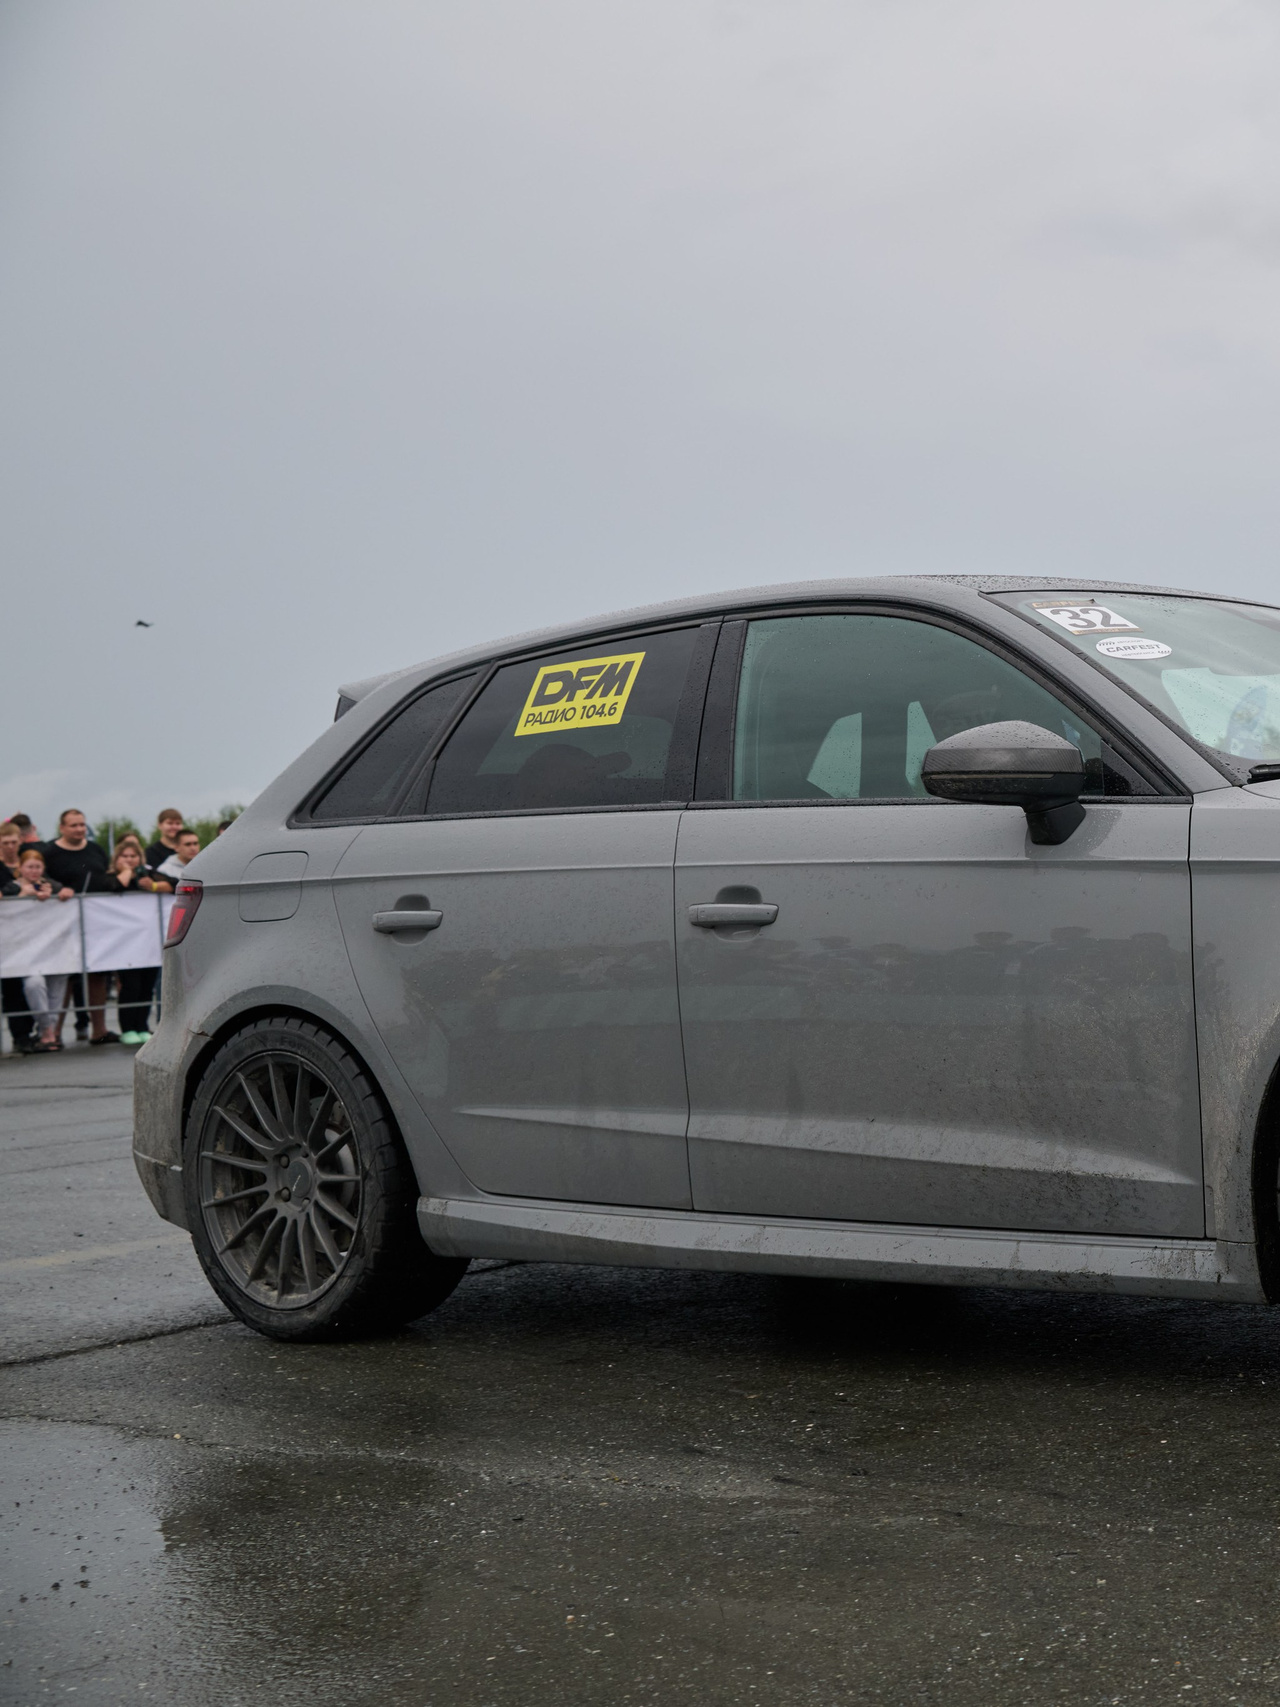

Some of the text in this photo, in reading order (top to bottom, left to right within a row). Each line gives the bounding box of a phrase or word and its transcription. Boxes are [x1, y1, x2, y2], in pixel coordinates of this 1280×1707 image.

[1050, 608, 1129, 628] 32
[1106, 644, 1160, 653] CARFEST
[531, 660, 636, 708] DFM
[523, 701, 619, 728] РАДИО 104.6
